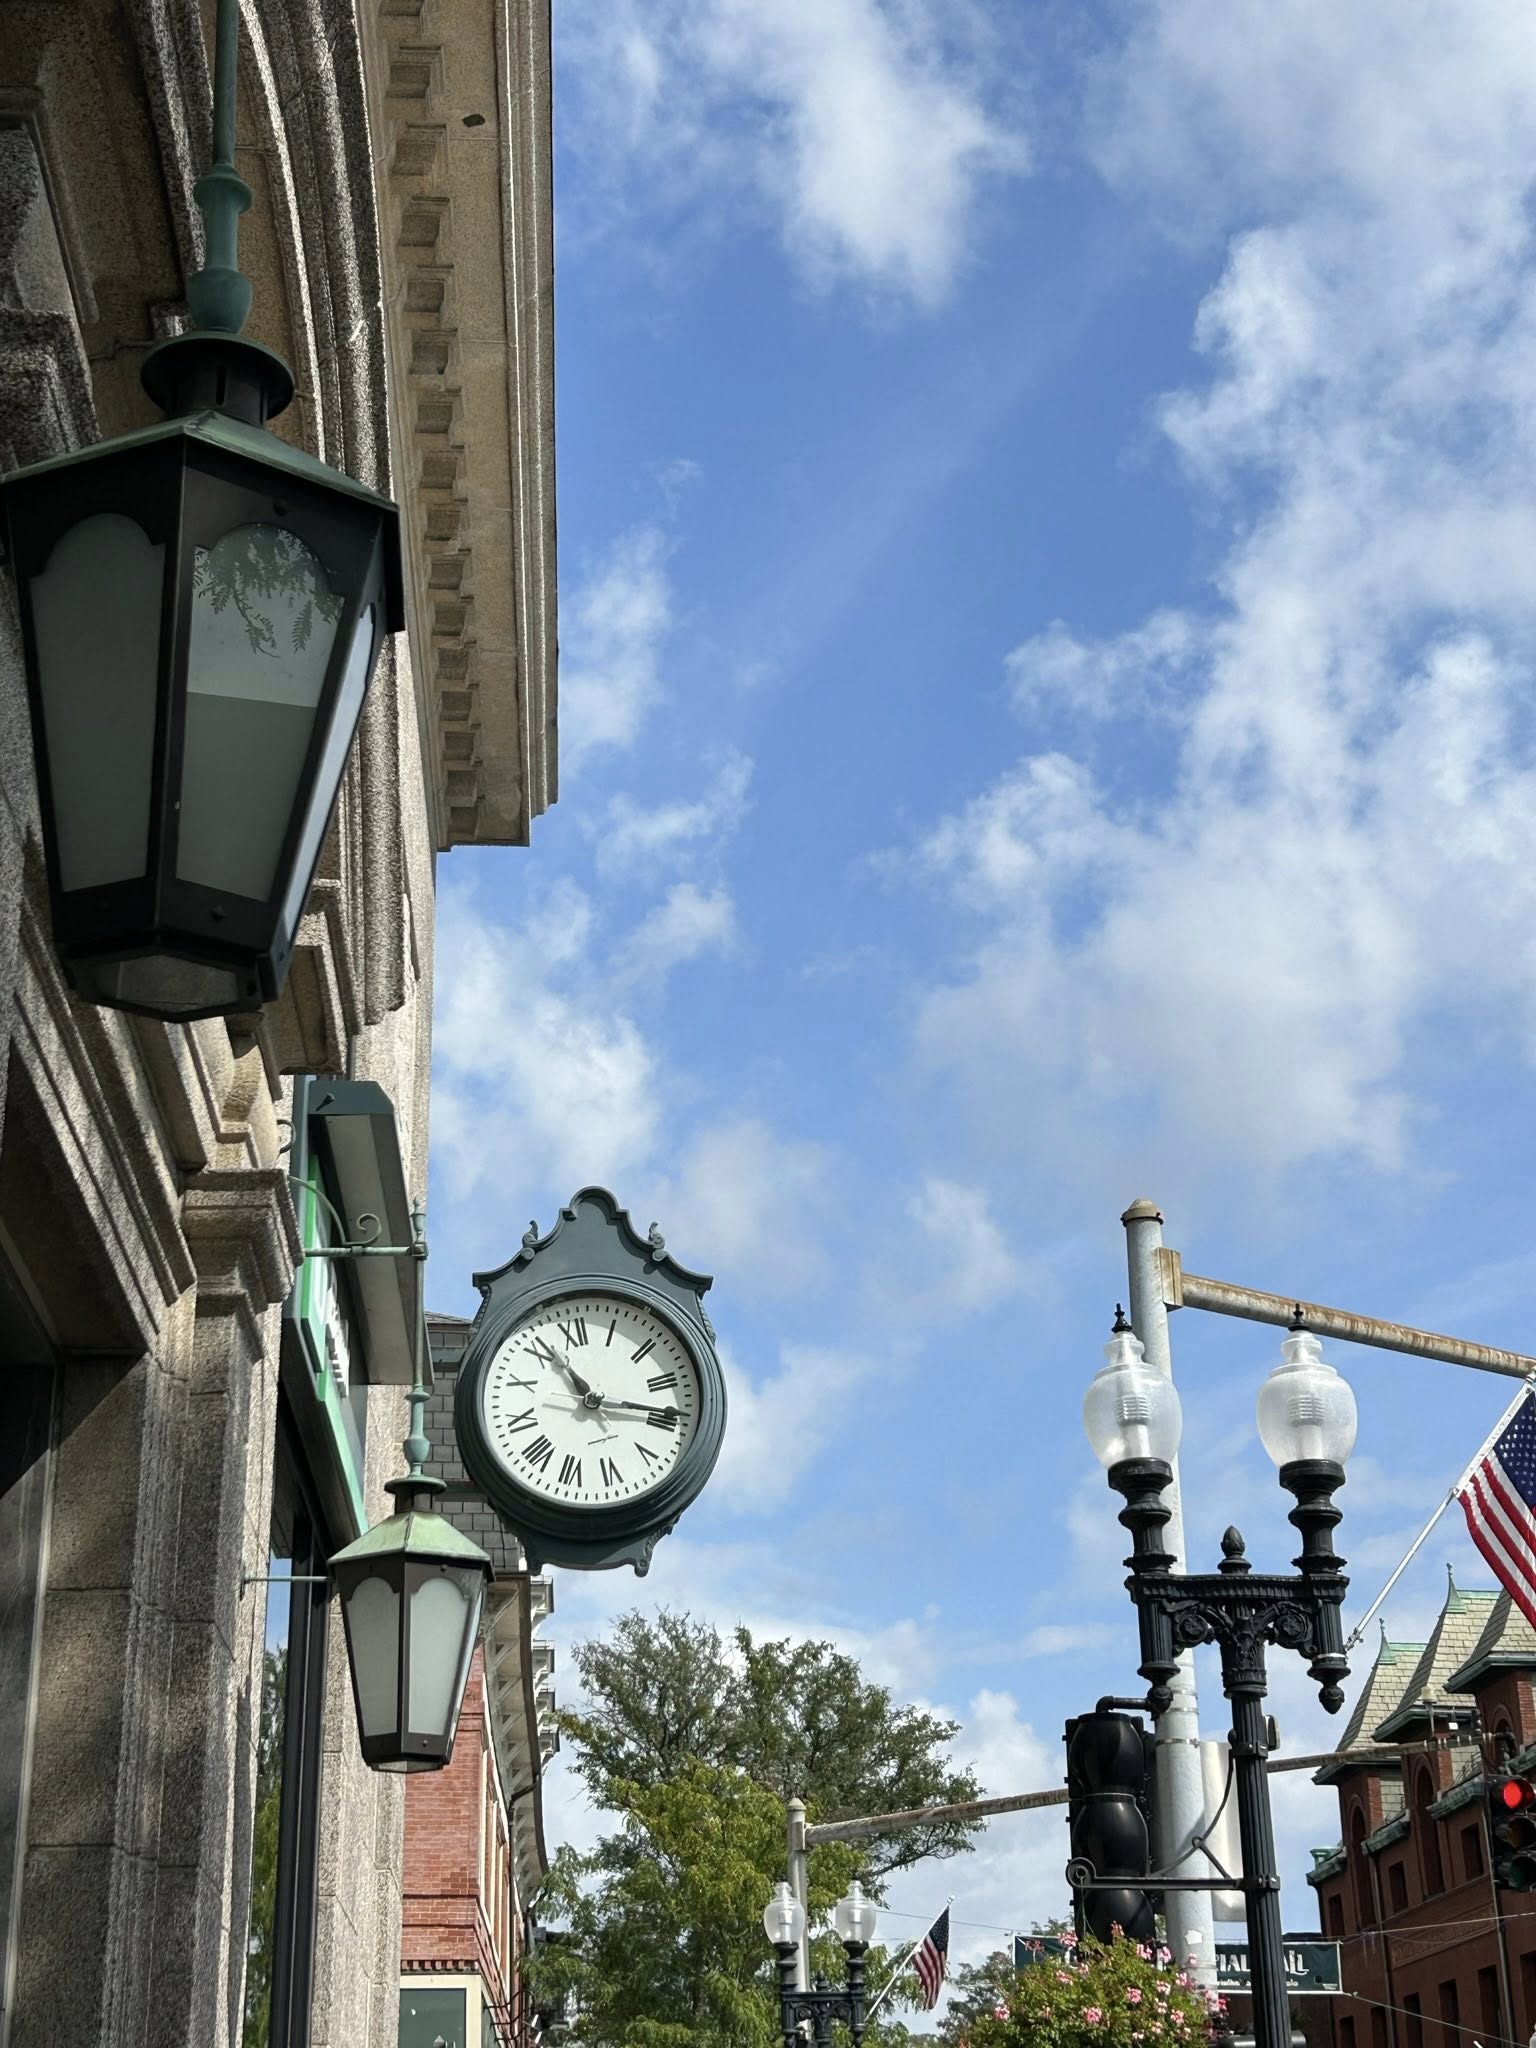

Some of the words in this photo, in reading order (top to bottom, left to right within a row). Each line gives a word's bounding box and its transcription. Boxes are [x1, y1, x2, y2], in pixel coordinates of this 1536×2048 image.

[557, 1317, 589, 1351] XII
[505, 1373, 539, 1394] X
[646, 1371, 679, 1393] III
[505, 1407, 539, 1434] IX
[521, 1434, 556, 1474] VIII
[633, 1441, 660, 1468] V
[558, 1454, 582, 1488] VII
[599, 1456, 625, 1487] VI
